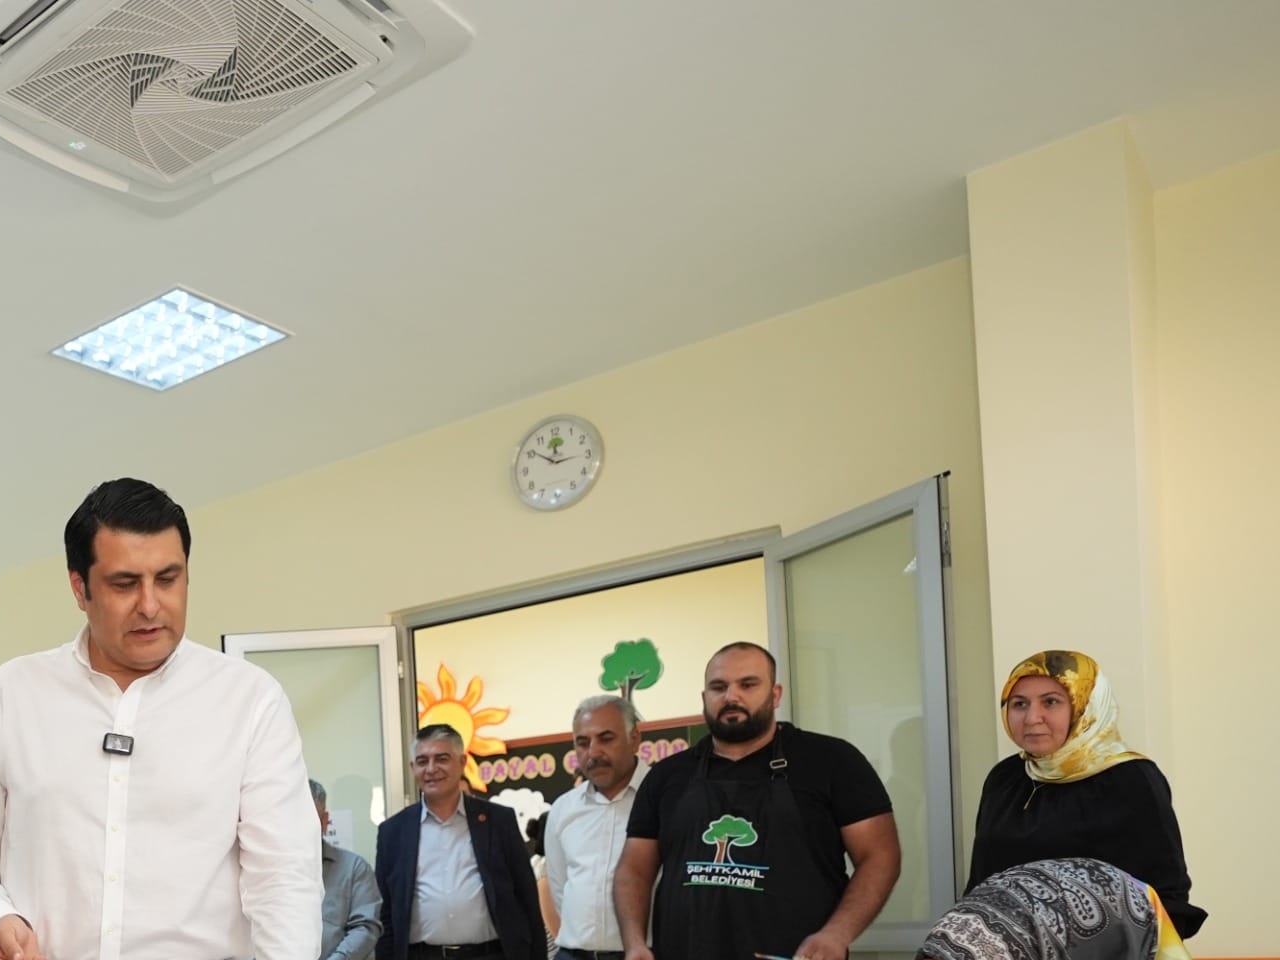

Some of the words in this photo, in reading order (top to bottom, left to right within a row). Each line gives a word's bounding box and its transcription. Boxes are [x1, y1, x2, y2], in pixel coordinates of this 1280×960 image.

[550, 427, 560, 436] 12
[569, 427, 573, 436] 1
[536, 436, 544, 446] 11
[579, 435, 586, 445] 2
[527, 449, 536, 459] 10
[585, 449, 591, 459] 3
[522, 467, 529, 477] 9
[581, 467, 587, 476] 4
[528, 481, 535, 490] 8
[570, 480, 576, 490] 5
[540, 488, 546, 498] 7
[479, 757, 553, 781] HAYAL
[687, 864, 765, 879] ŞEHİTKAMİL
[690, 874, 756, 889] BELEDİYESİ
